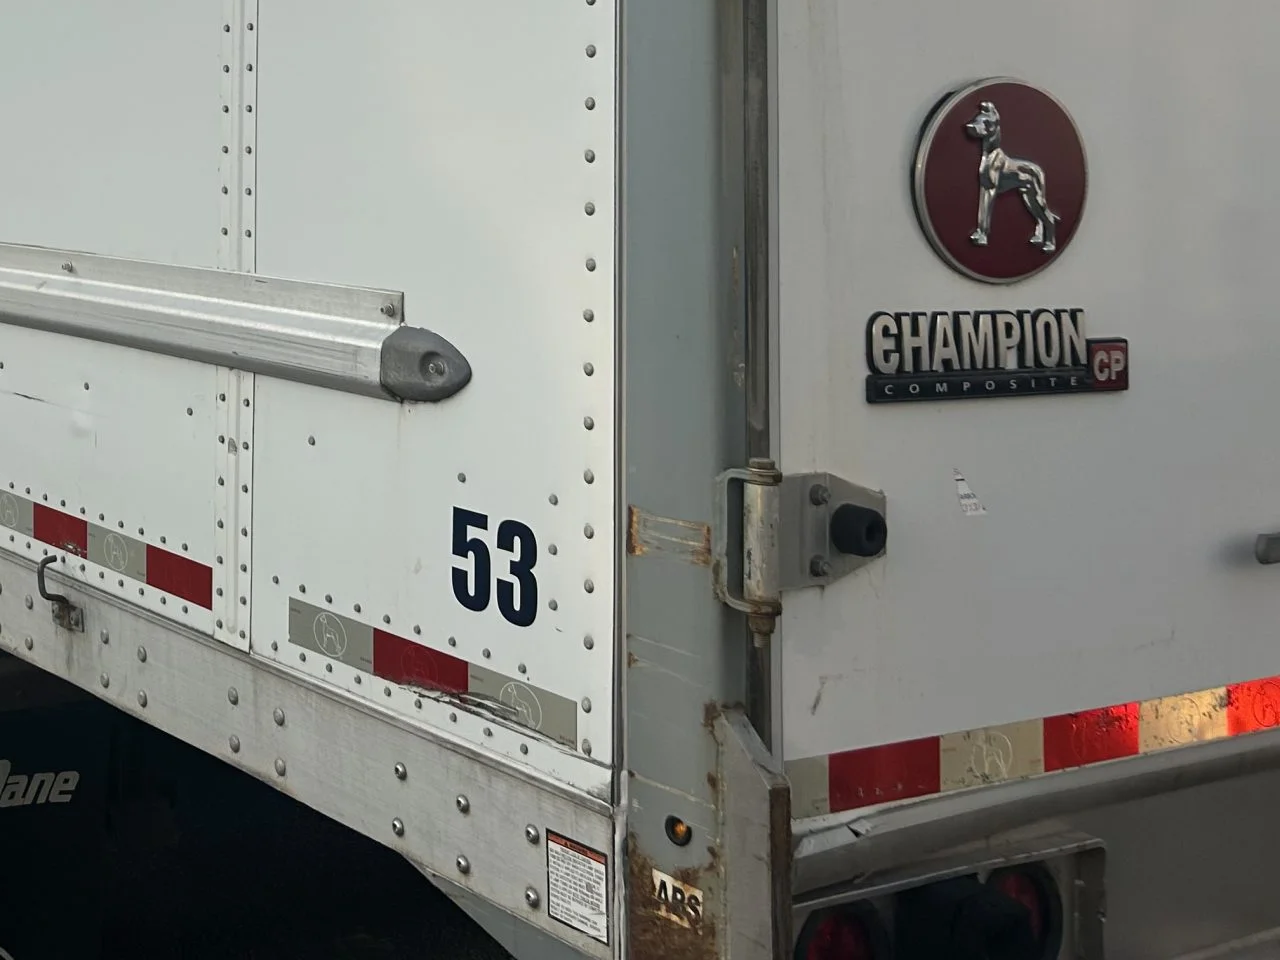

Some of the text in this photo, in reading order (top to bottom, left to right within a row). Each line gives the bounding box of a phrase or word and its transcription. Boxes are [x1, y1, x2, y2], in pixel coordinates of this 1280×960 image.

[868, 308, 1088, 374] CHAMPION
[884, 376, 1078, 395] COMPOSITE
[1093, 350, 1125, 381] CP
[451, 506, 538, 627] 53
